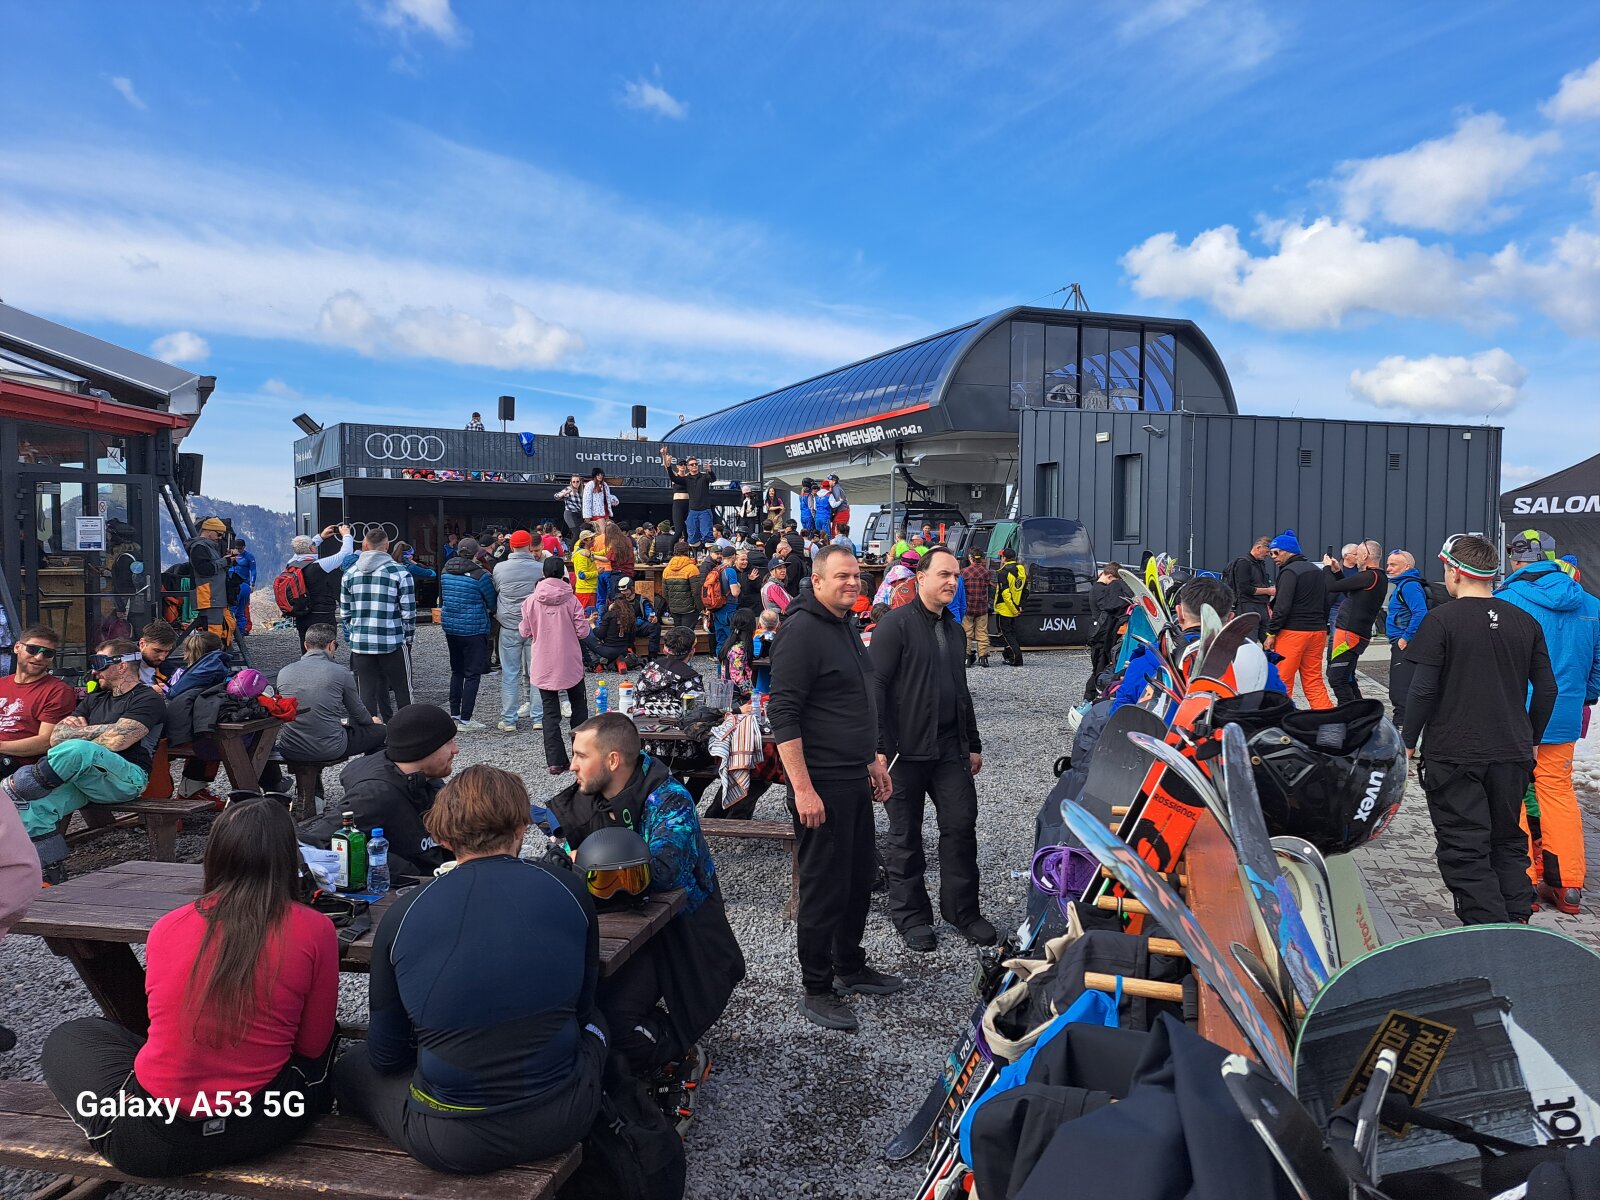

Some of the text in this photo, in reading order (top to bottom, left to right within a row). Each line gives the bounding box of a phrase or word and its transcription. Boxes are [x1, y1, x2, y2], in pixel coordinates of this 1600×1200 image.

[575, 452, 628, 462] quattro
[630, 453, 643, 465] je
[1039, 615, 1077, 631] JASNÁ
[1153, 793, 1197, 821] ROSSIGNOL
[1353, 770, 1385, 822] uvex
